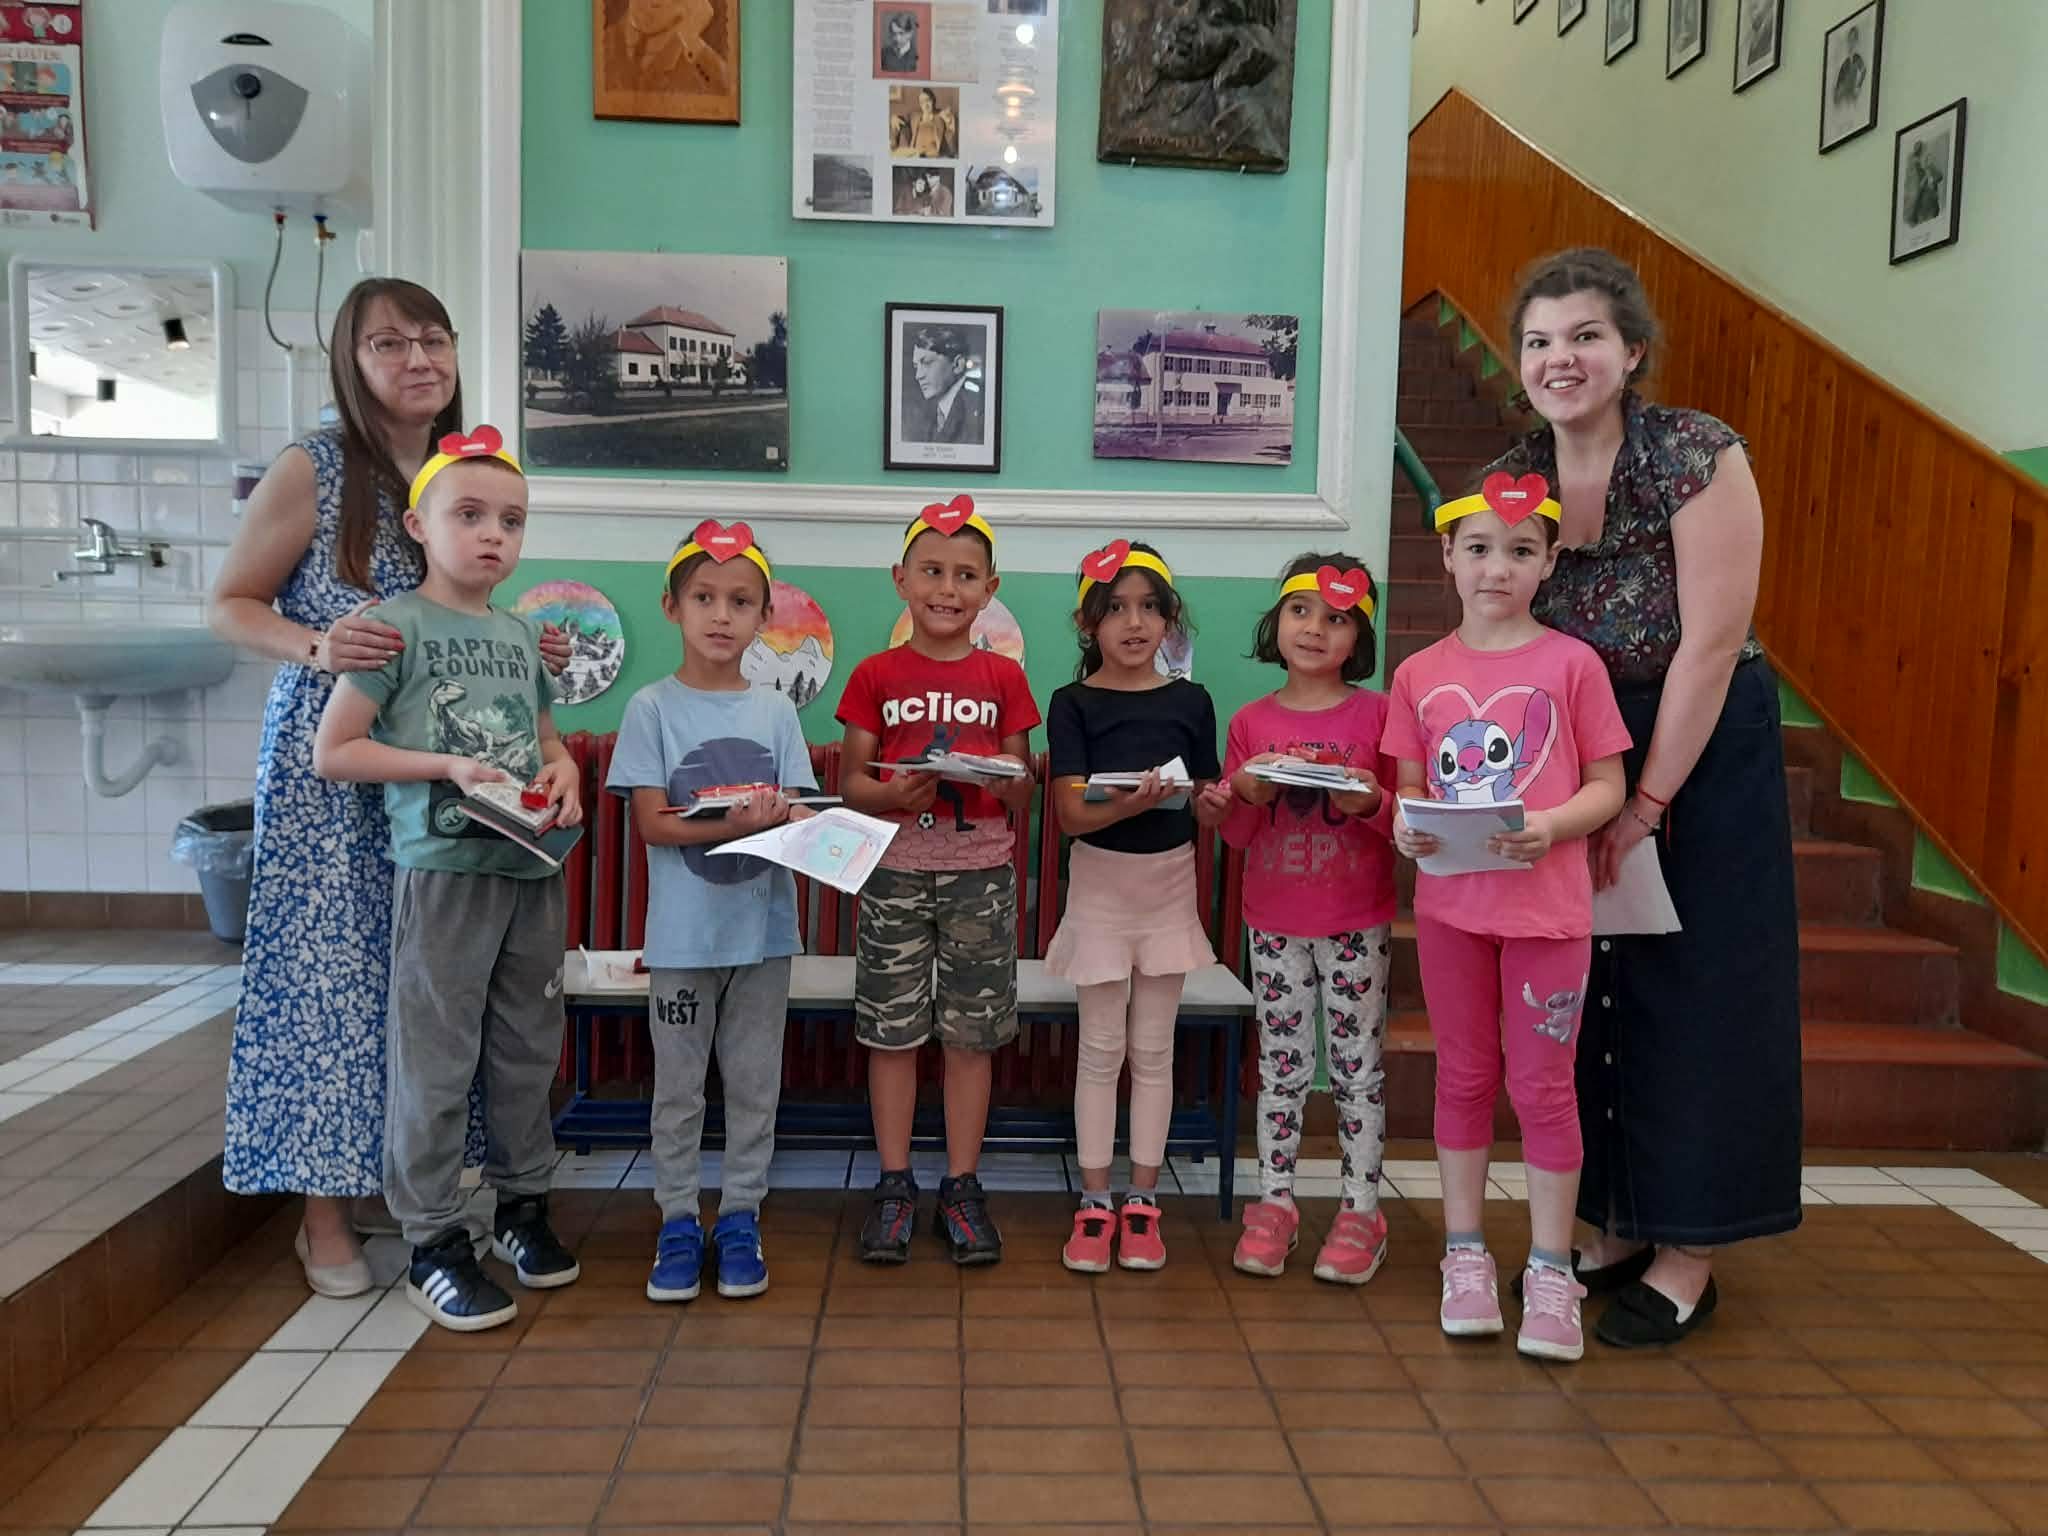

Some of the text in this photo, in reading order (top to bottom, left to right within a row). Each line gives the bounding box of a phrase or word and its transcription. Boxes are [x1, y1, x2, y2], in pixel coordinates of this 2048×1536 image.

[422, 637, 527, 663] RAPTOR
[428, 659, 529, 681] COUNTRY
[656, 995, 700, 1025] WEST
